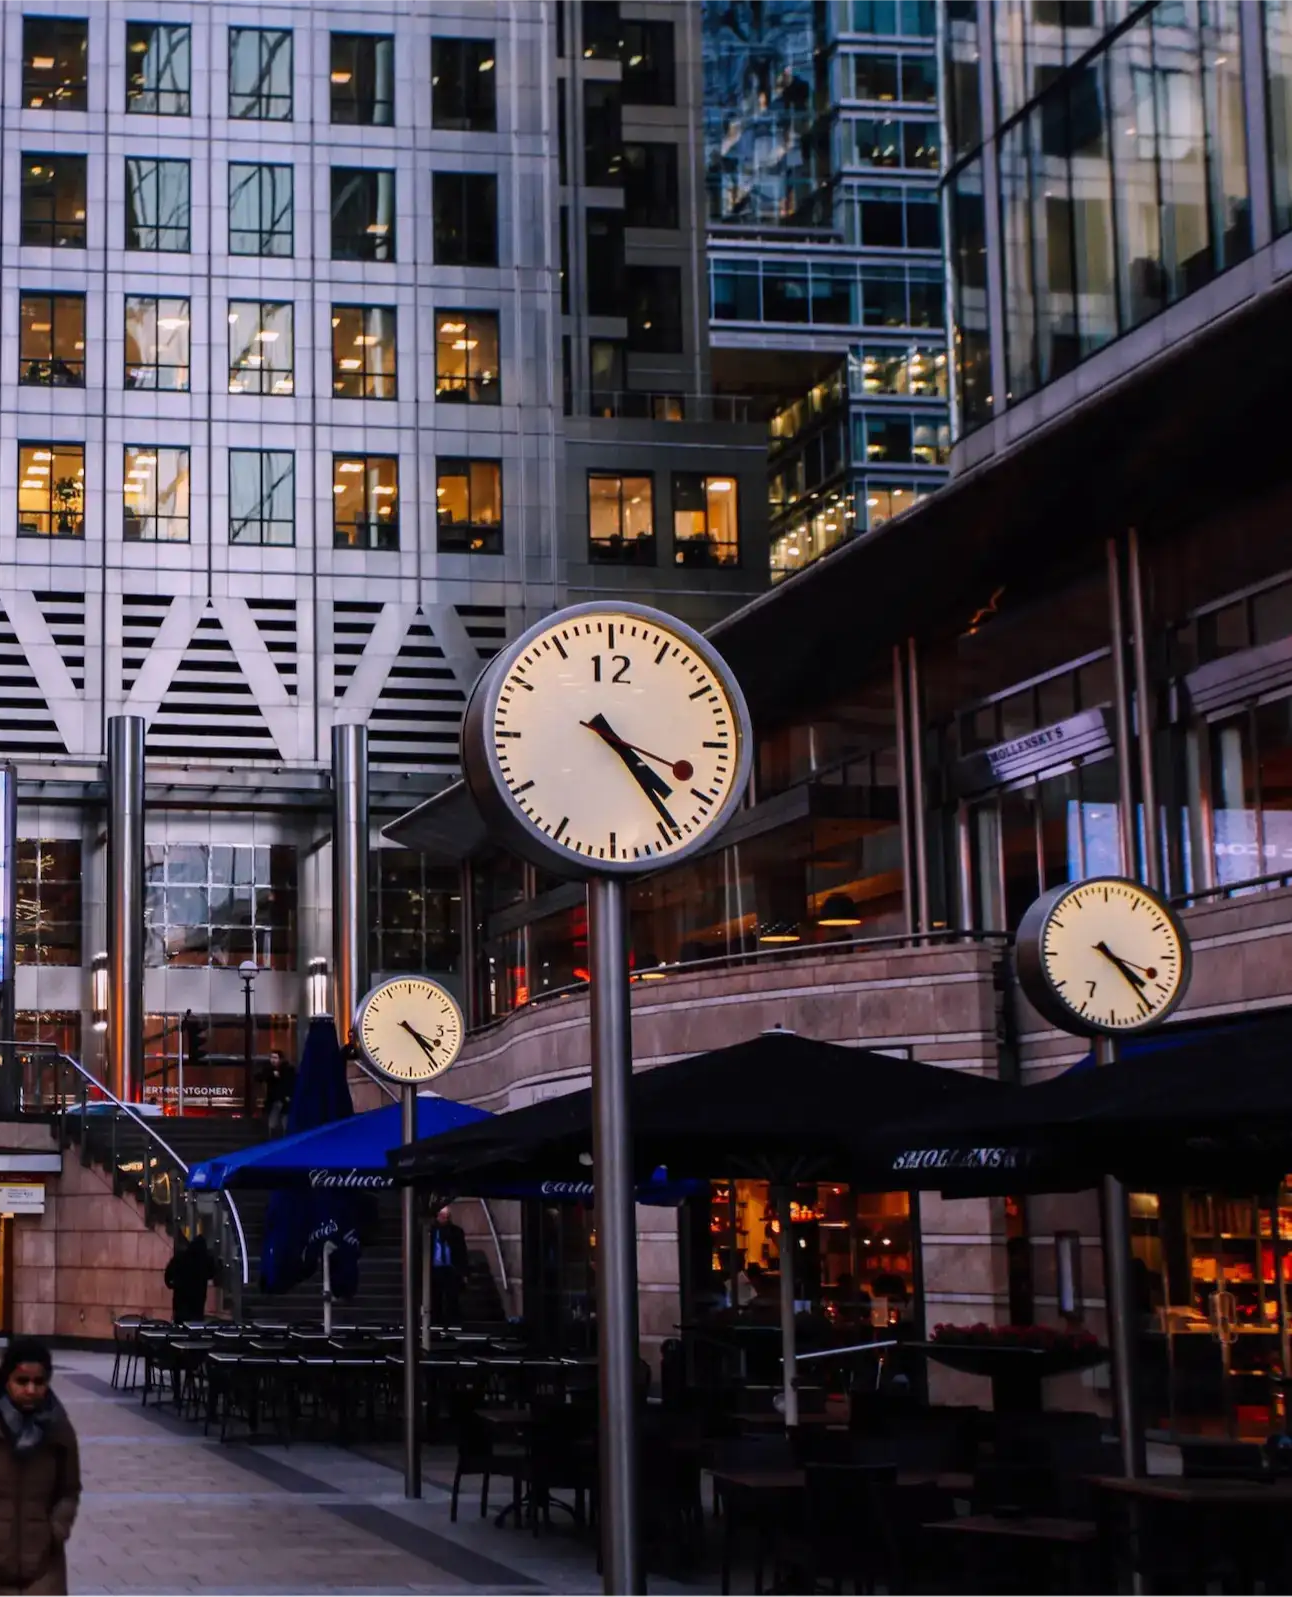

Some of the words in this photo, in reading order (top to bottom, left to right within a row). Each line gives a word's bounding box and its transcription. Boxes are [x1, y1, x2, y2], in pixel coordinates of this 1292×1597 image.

[591, 655, 631, 684] 12
[1085, 981, 1096, 998] 7
[436, 1025, 444, 1037] 3
[145, 1086, 164, 1095] ERT
